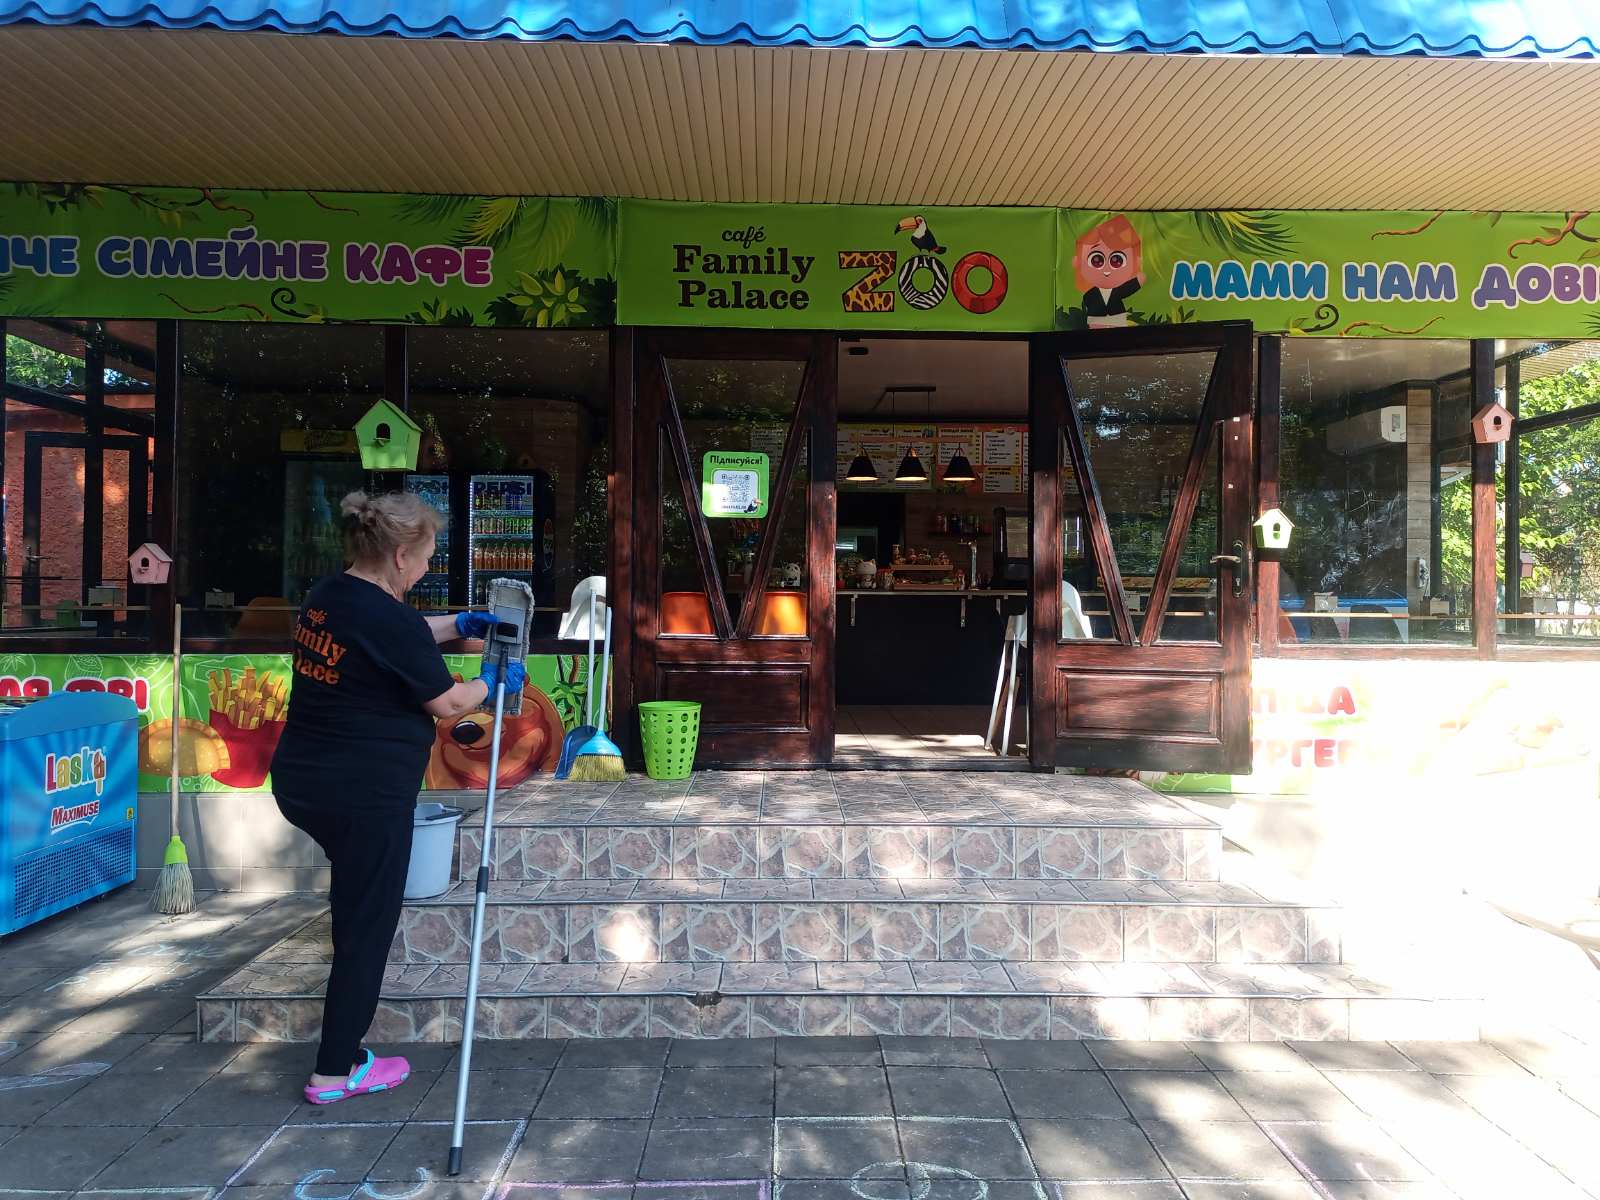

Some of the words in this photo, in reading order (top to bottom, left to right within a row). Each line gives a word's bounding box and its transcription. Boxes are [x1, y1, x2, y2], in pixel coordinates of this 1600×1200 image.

[97, 227, 328, 280] СІМЕЙНЕ
[346, 242, 493, 286] КАФЕ
[722, 226, 767, 249] café
[672, 244, 815, 283] Family
[838, 249, 1009, 314] ZOO
[1170, 261, 1329, 302] МАМИ
[1342, 262, 1458, 303] НАМ
[1472, 263, 1599, 310] ДОВІ
[678, 279, 810, 310] Palace
[709, 454, 763, 466] Підписуйся!
[294, 615, 347, 666] amily
